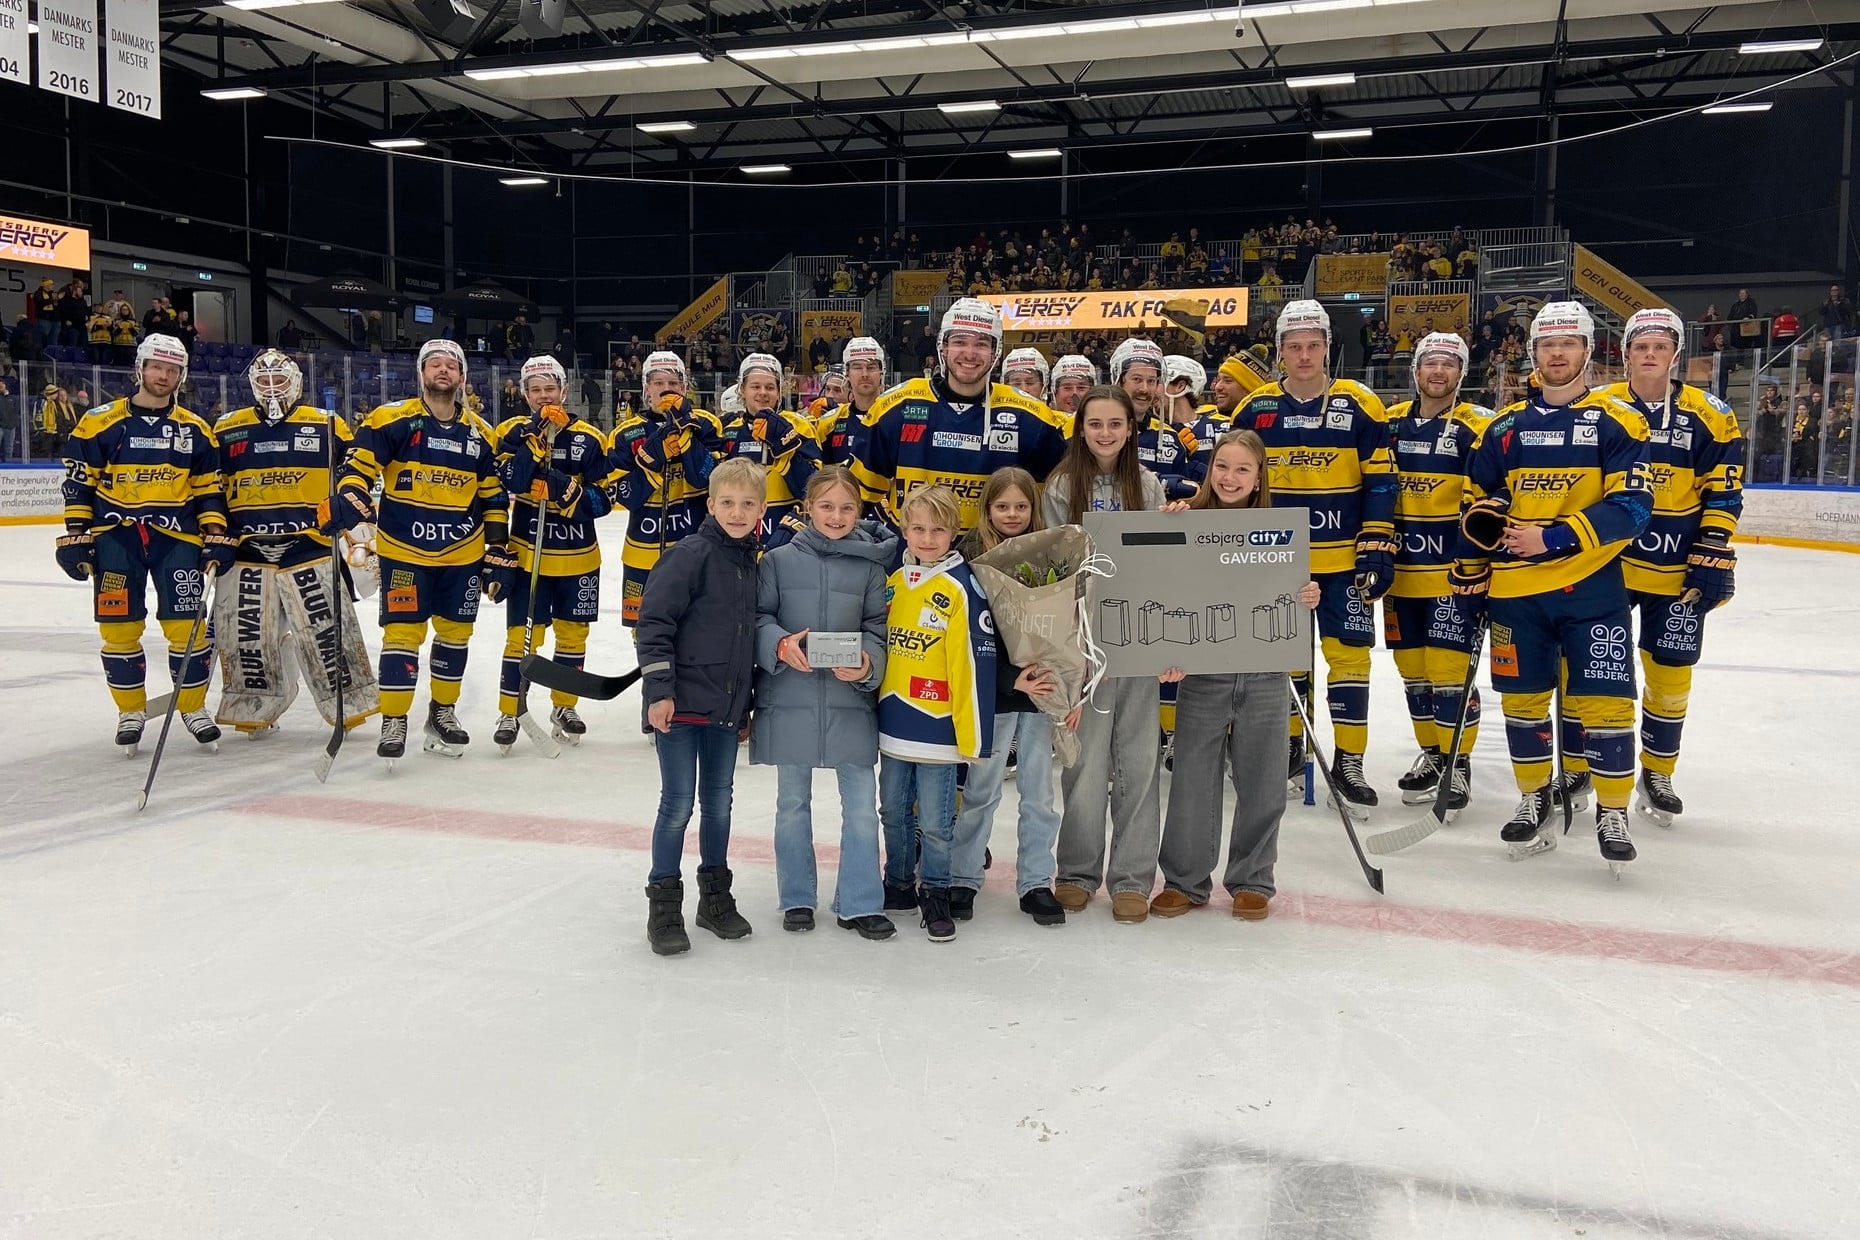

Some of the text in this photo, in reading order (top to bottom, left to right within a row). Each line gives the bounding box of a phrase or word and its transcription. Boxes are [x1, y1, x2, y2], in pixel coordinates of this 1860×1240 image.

[44, 7, 93, 34] DANMARKS
[51, 29, 86, 51] MESTER
[111, 28, 155, 54] DANMARKS
[118, 50, 149, 70] MESTER
[49, 70, 89, 95] 2016
[116, 89, 152, 112] 2017
[331, 284, 368, 292] ROYAL
[1581, 267, 1645, 311] DEN GULE
[467, 292, 501, 300] ROYAL
[1015, 296, 1078, 305] ESBJERG
[702, 294, 723, 314] MUR
[1100, 300, 1138, 318] TAK
[1394, 299, 1465, 314] ENERGY
[804, 316, 858, 328] ENERGY
[954, 313, 970, 321] West
[972, 314, 993, 325] Diesel
[1538, 317, 1579, 327] West Diesel
[162, 425, 173, 437] C
[936, 440, 963, 448] GROUP
[1266, 453, 1340, 467] ENERGY
[16, 477, 49, 487] ingenuity
[117, 471, 184, 483] ENERGY
[239, 472, 308, 486] ENERGY
[414, 471, 475, 488] ENERGY
[15, 487, 41, 498] people
[41, 486, 61, 495] creat
[1, 499, 31, 508] endless
[411, 516, 475, 542] OBTON
[1197, 531, 1277, 547] esbjerg city
[1219, 551, 1295, 565] GAVEKORT
[292, 567, 332, 625] BLUE
[237, 567, 268, 690] BLUE WATER
[1432, 622, 1464, 634] OPLEV
[1428, 629, 1466, 643] ESBJERG
[1663, 632, 1696, 643] OPLEV
[1656, 638, 1697, 652] ESBJERG
[1589, 660, 1626, 672] OPLEV
[1584, 669, 1630, 682] ESBJERG
[919, 690, 939, 701] ZPD
